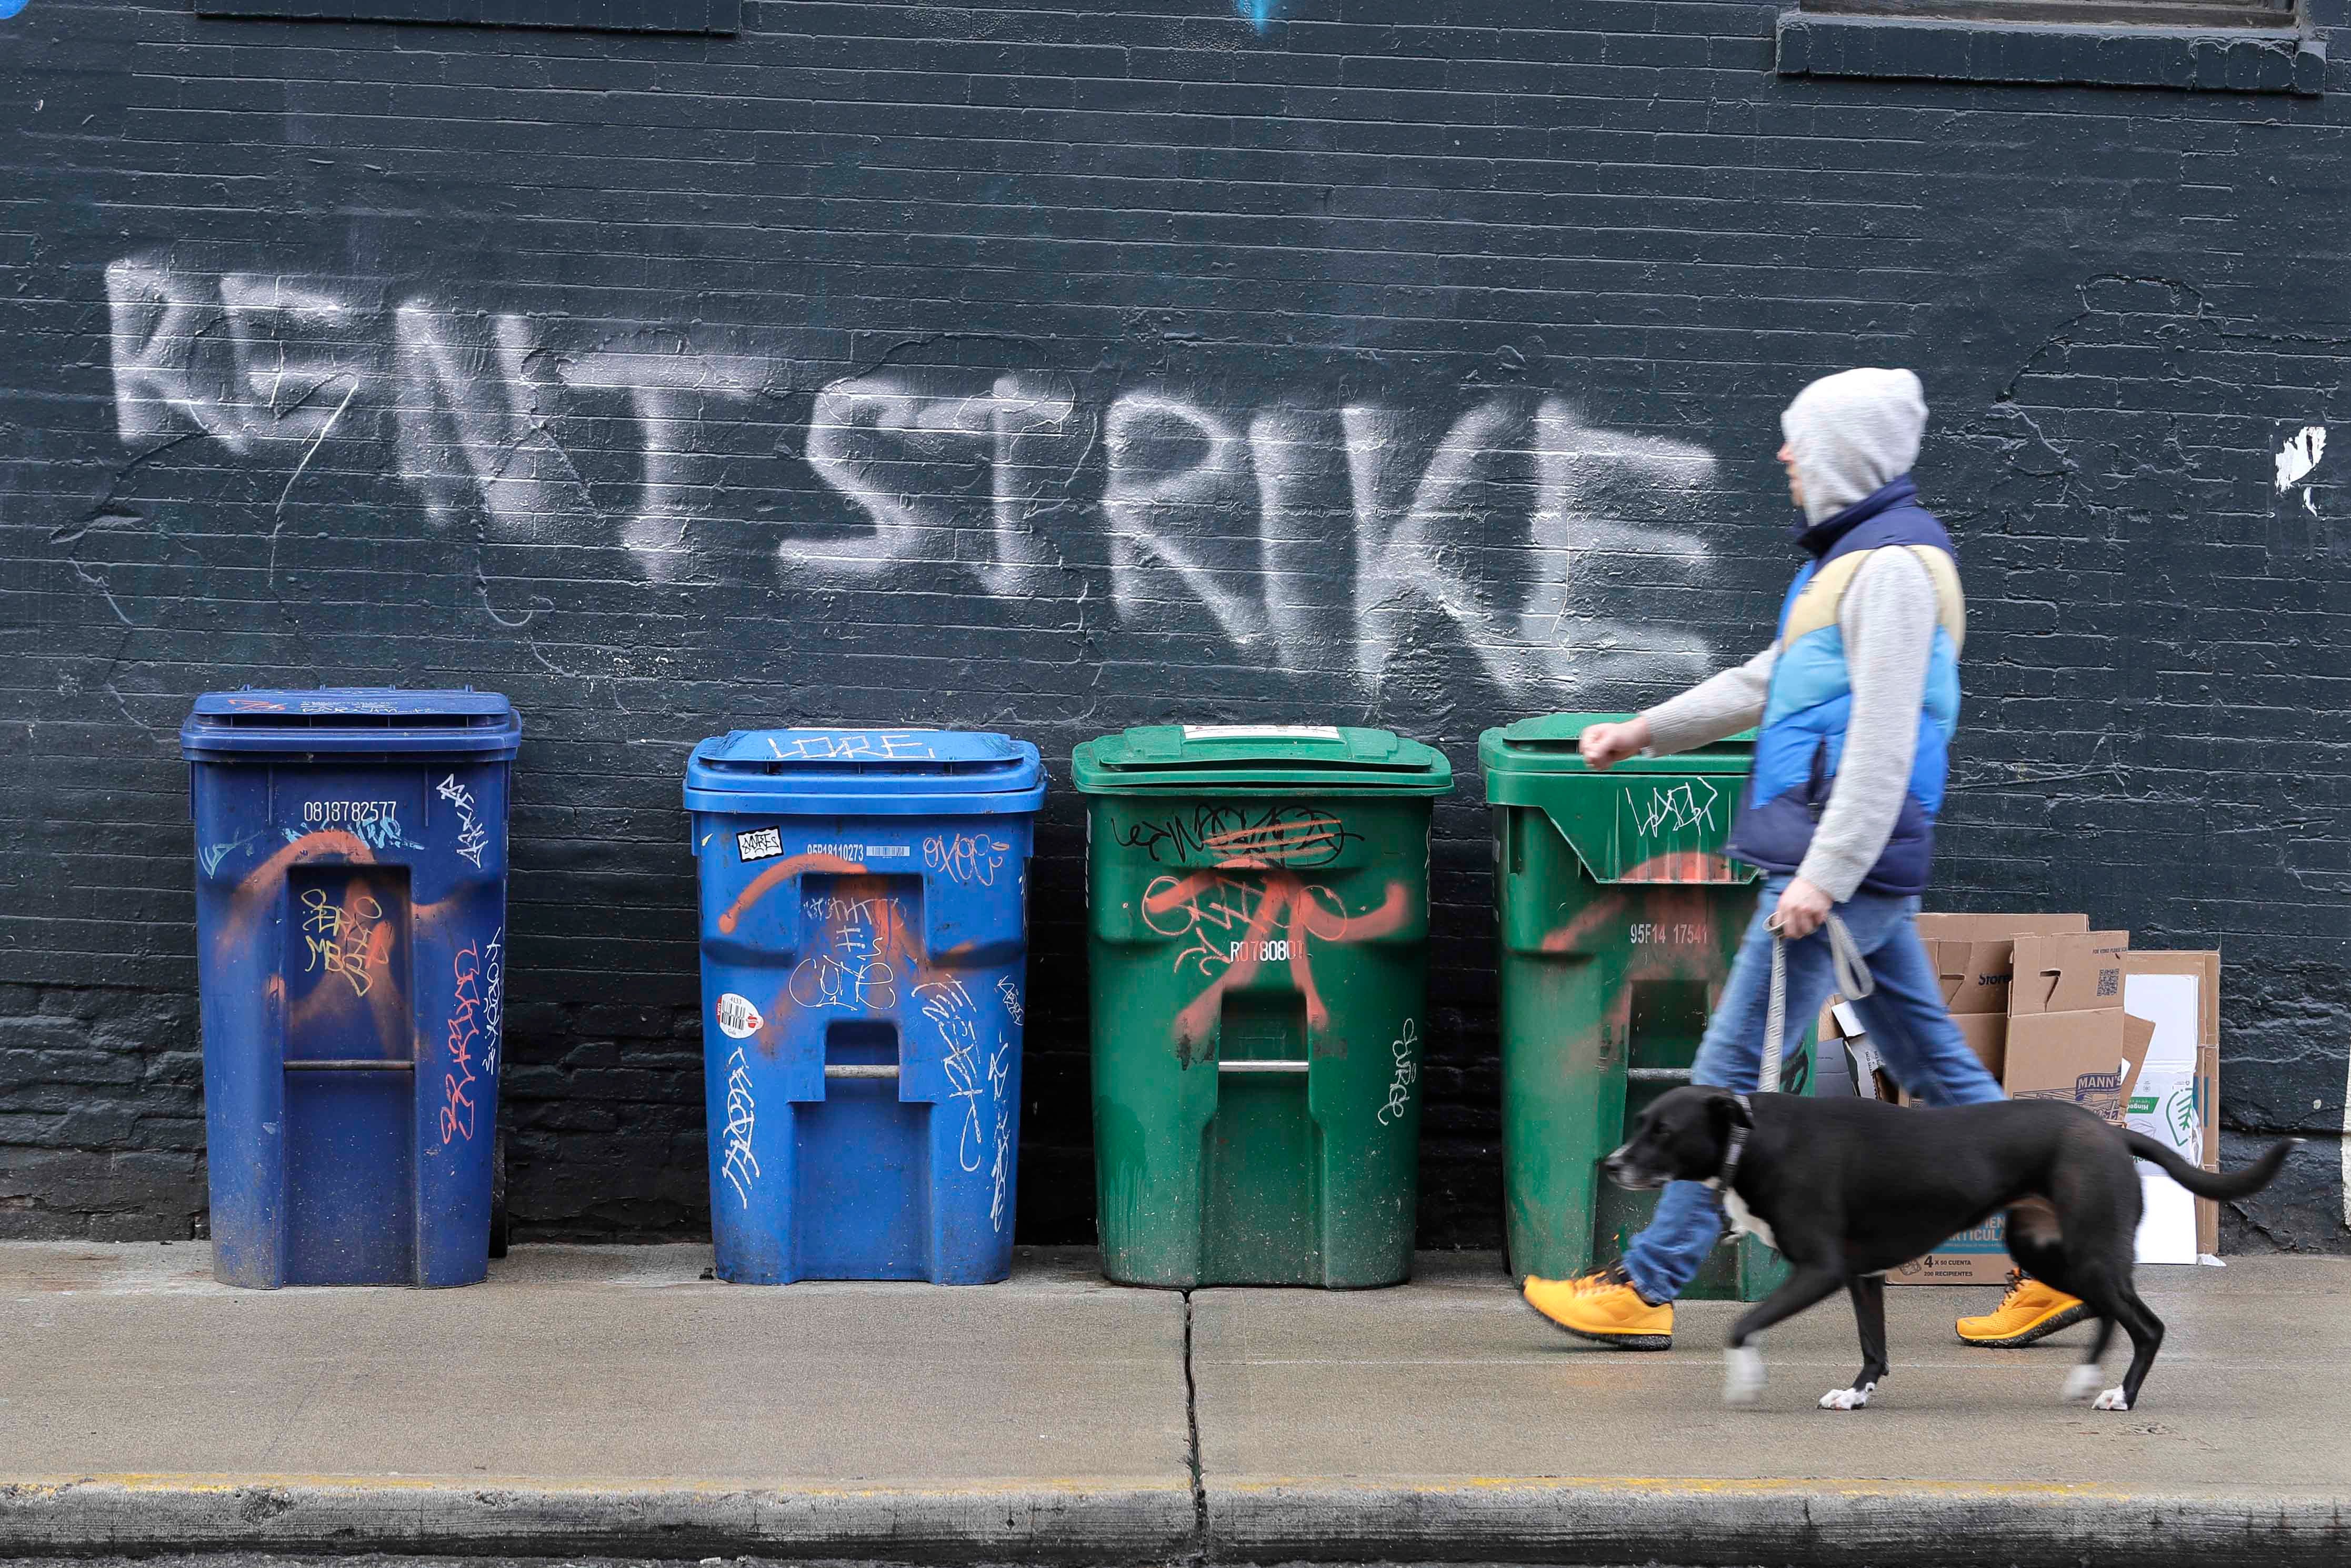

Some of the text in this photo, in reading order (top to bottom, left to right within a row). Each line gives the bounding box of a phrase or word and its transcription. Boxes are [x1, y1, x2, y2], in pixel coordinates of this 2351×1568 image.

[107, 256, 1718, 703] RENT STRIKE
[304, 801, 397, 822] 0818782577
[2078, 1075, 2121, 1089] MANN'S
[1924, 1255, 1934, 1268] 4
